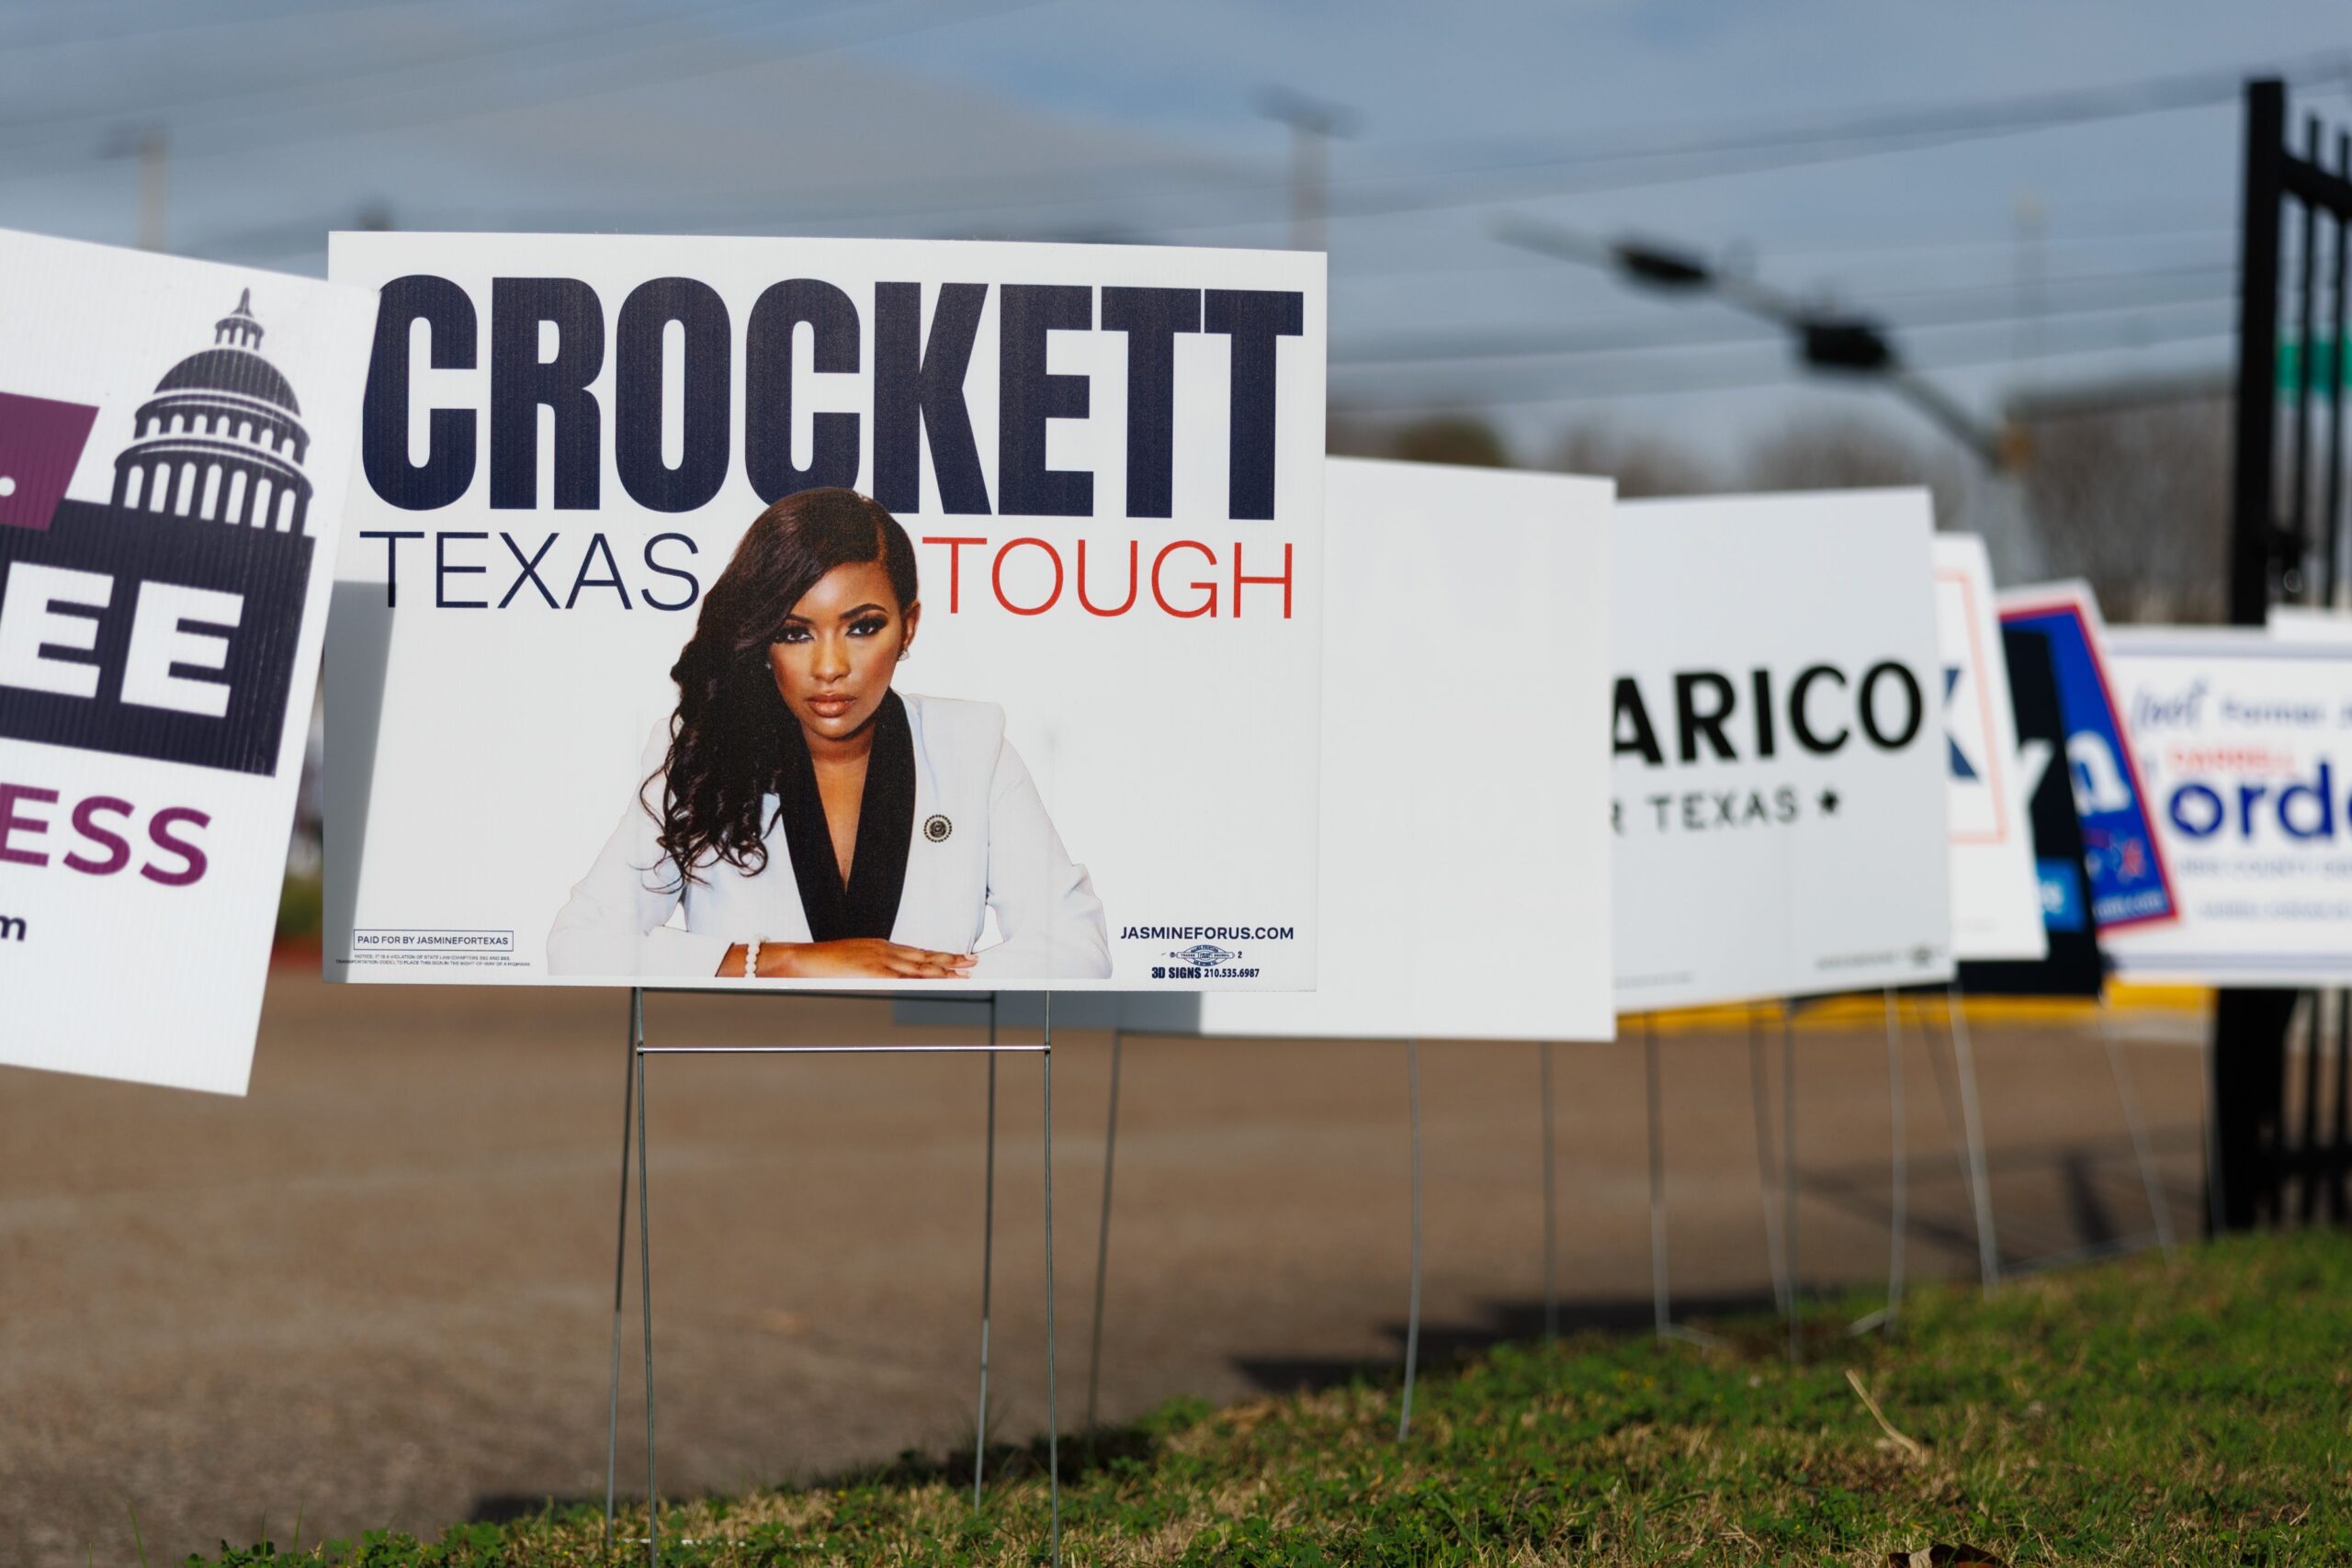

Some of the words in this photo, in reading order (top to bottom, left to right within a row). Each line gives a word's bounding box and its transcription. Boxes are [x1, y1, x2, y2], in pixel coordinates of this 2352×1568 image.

[362, 274, 1304, 521] CROCKETT
[359, 530, 700, 612] TEXAS
[922, 536, 1293, 619] TOUGH
[1612, 660, 1922, 766] ARICO
[1645, 786, 1799, 831] TEXAS
[2169, 759, 2352, 840] ord
[357, 935, 379, 944] PAID
[381, 936, 401, 944] FOR
[402, 936, 414, 945] BY
[416, 935, 509, 945] JASMINEFORTEXAS
[1120, 926, 1295, 940] JASMINEFORUS.COM
[1238, 951, 1243, 959] 2
[1151, 967, 1166, 979] 3D
[1168, 967, 1202, 979] SIGNS
[1204, 968, 1260, 978] 210.535.6987
